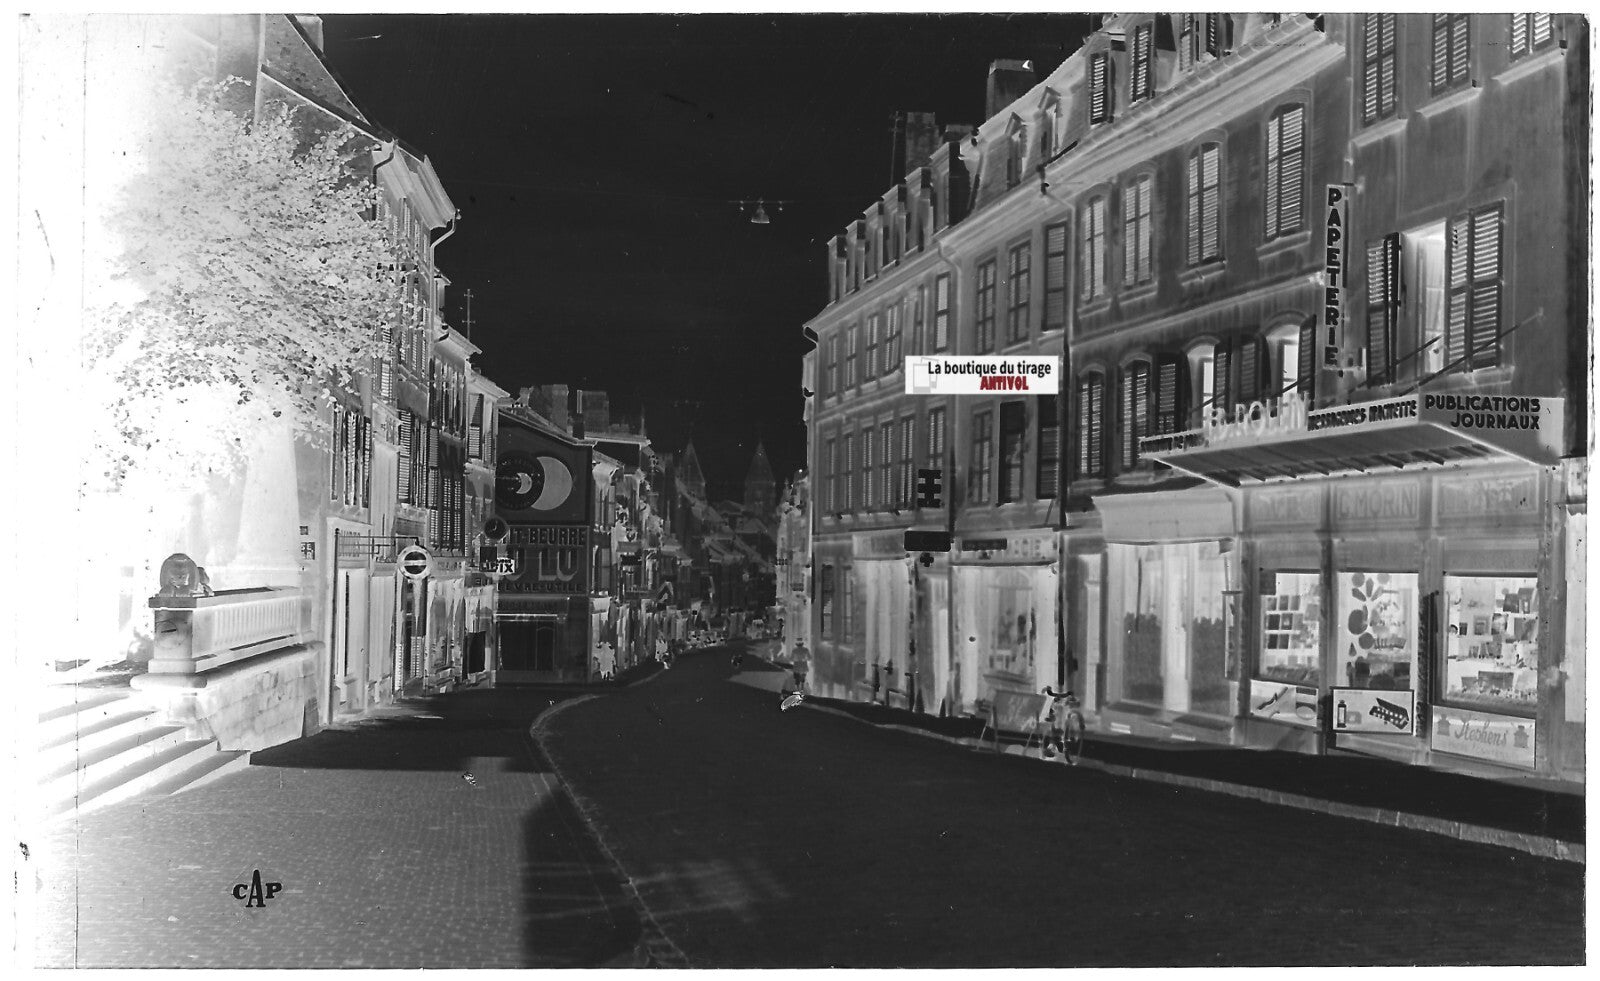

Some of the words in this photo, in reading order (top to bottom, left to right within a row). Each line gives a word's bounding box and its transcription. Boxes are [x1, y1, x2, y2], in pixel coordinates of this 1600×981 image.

[1325, 187, 1342, 366] PAPETERIE
[1425, 395, 1541, 413] PUBLICATIONS
[1451, 413, 1540, 430] JOURNAUX
